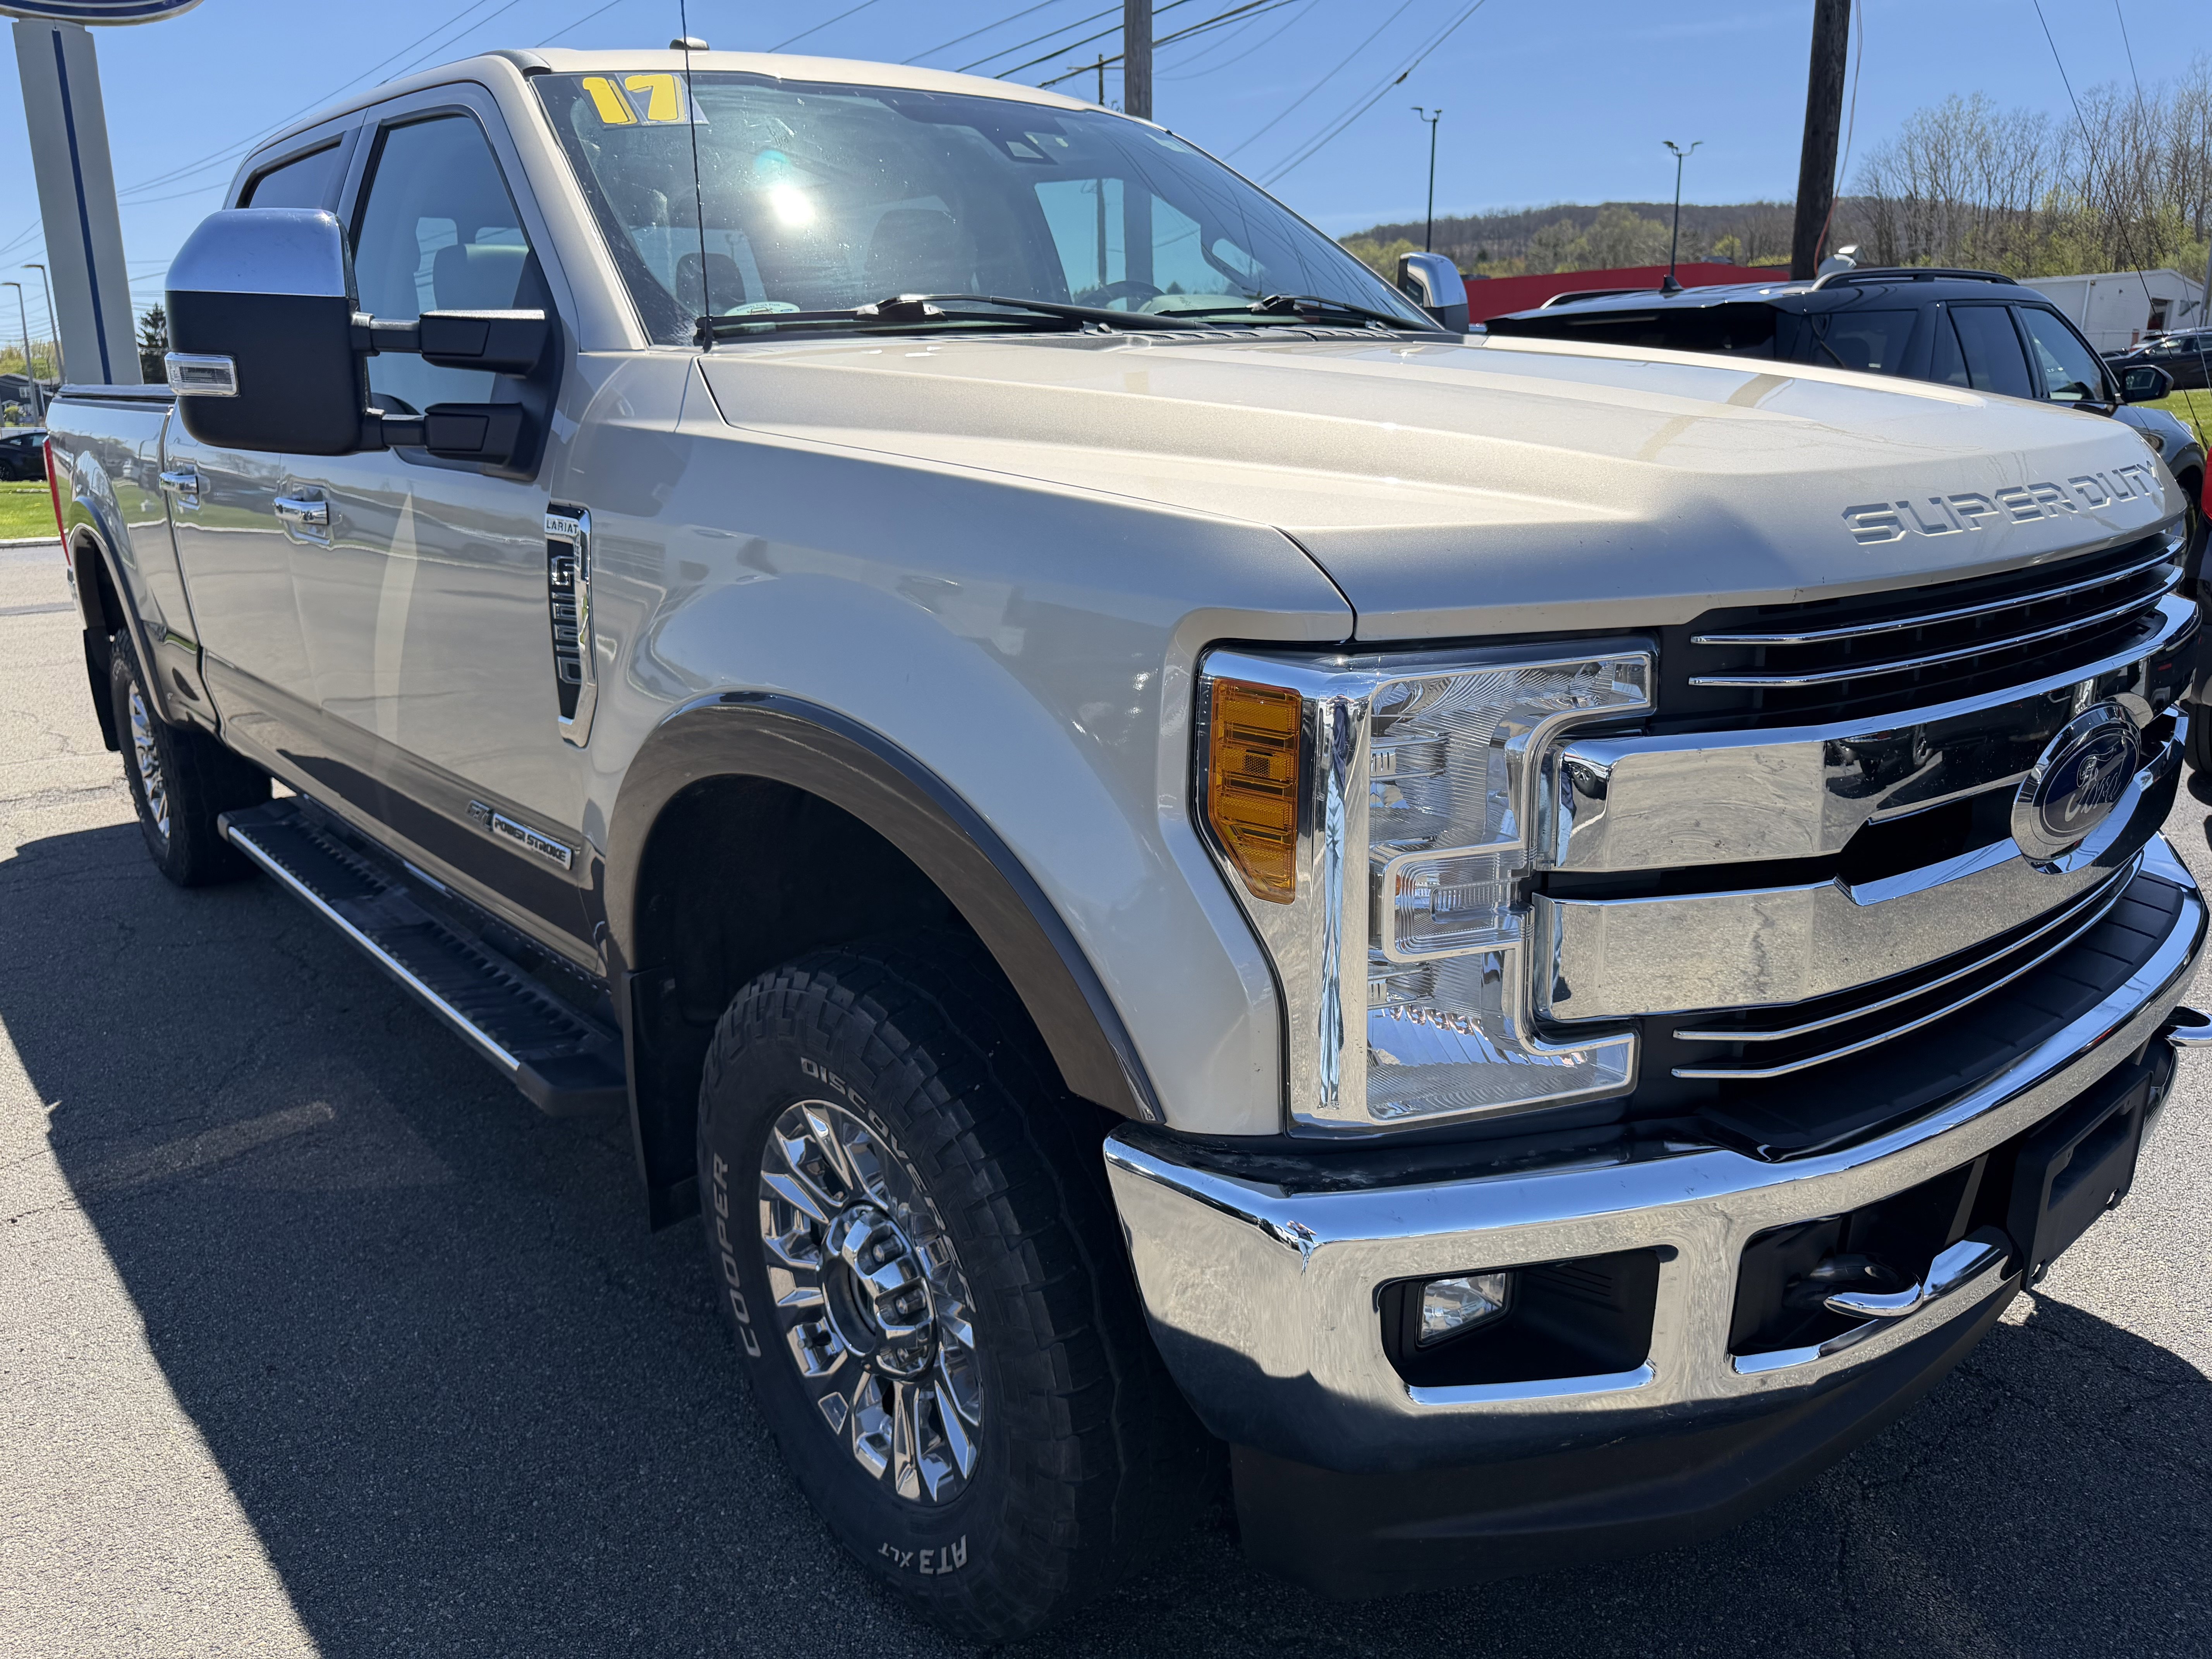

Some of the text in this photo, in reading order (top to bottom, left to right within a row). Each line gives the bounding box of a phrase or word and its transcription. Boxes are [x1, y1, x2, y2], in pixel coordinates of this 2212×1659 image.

[583, 74, 678, 124] 17
[546, 520, 579, 534] LARIAT
[1841, 460, 2165, 545] SUPER DUTY
[2064, 742, 2126, 822] Ford
[495, 817, 526, 843] POWER
[527, 834, 566, 863] STROKE
[800, 1057, 977, 1312] DISCOVERER
[713, 1152, 761, 1357] COOPER
[878, 1534, 967, 1575] AT3 XLT
